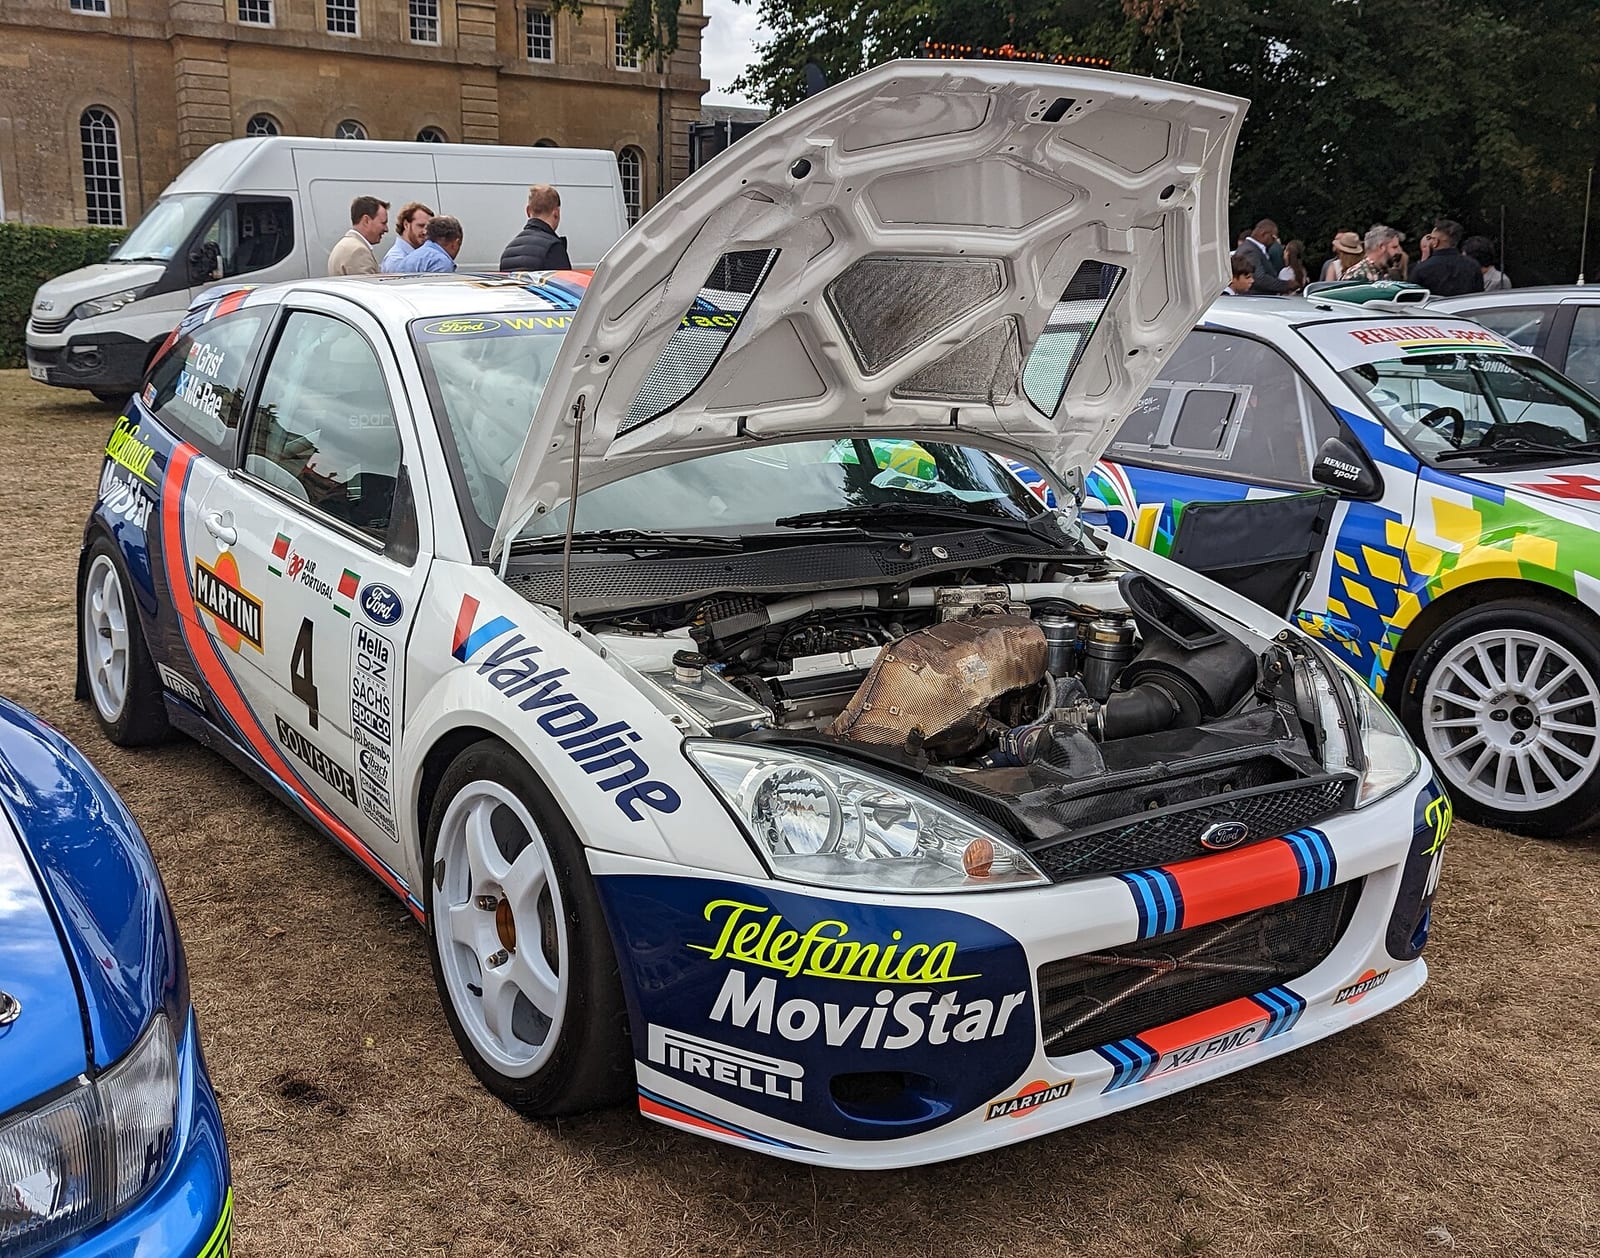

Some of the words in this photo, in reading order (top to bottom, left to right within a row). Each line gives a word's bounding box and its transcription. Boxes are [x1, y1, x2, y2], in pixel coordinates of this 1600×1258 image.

[439, 320, 484, 332] Ford
[1348, 326, 1449, 344] RENAULT
[196, 344, 224, 378] Grist
[1323, 456, 1362, 474] RENAULT
[1333, 469, 1359, 480] sport
[304, 560, 316, 574] AIR
[300, 572, 333, 600] PORTUGAL
[196, 569, 260, 641] MARTINI
[365, 586, 394, 621] Ford
[358, 629, 389, 663] Hella
[157, 662, 205, 711] PIRELLI
[291, 617, 319, 731] 4
[357, 670, 386, 692] RACING
[353, 677, 389, 717] SACHS
[353, 702, 390, 738] sparco
[476, 634, 681, 822] Valvoline
[279, 720, 354, 801] SOLVERDE
[360, 750, 388, 779] Eibach
[1216, 827, 1240, 843] Ford
[1337, 973, 1387, 1002] MARTINI
[709, 968, 1026, 1050] MoviStar
[647, 1022, 804, 1102] PIRELLI
[1163, 1047, 1200, 1071] X4
[1200, 1027, 1256, 1059] FMC
[991, 1084, 1069, 1118] MARTINI
